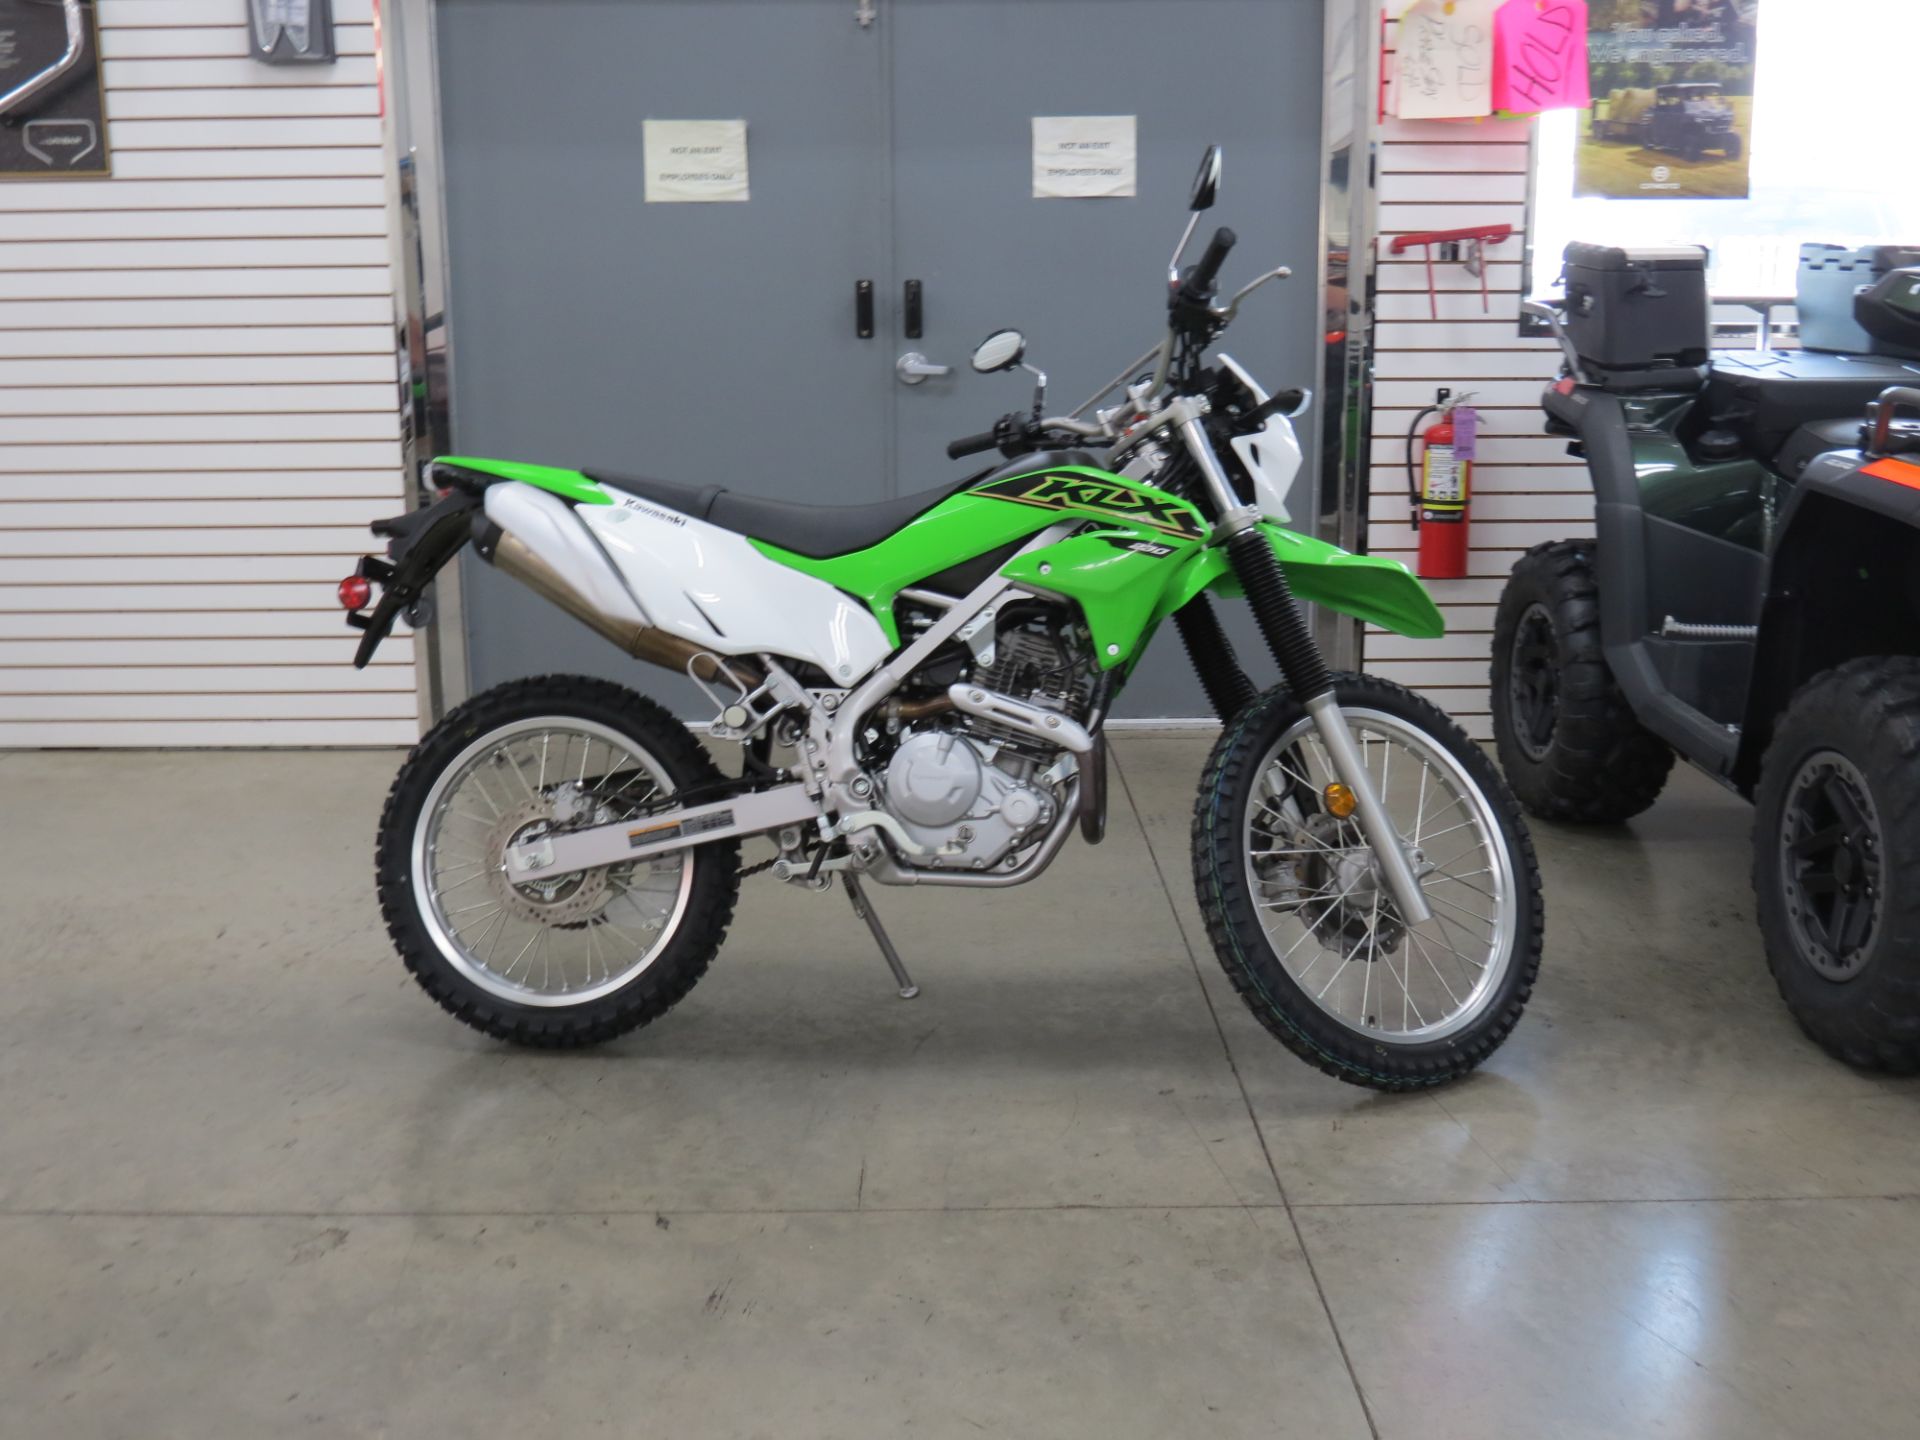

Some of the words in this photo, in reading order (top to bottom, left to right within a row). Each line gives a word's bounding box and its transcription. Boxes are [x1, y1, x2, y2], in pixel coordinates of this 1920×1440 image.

[1611, 22, 1653, 43] You
[1511, 6, 1575, 106] HOLD
[1586, 43, 1622, 63] We
[622, 498, 687, 528] Kawasaki
[1020, 476, 1184, 531] KLX
